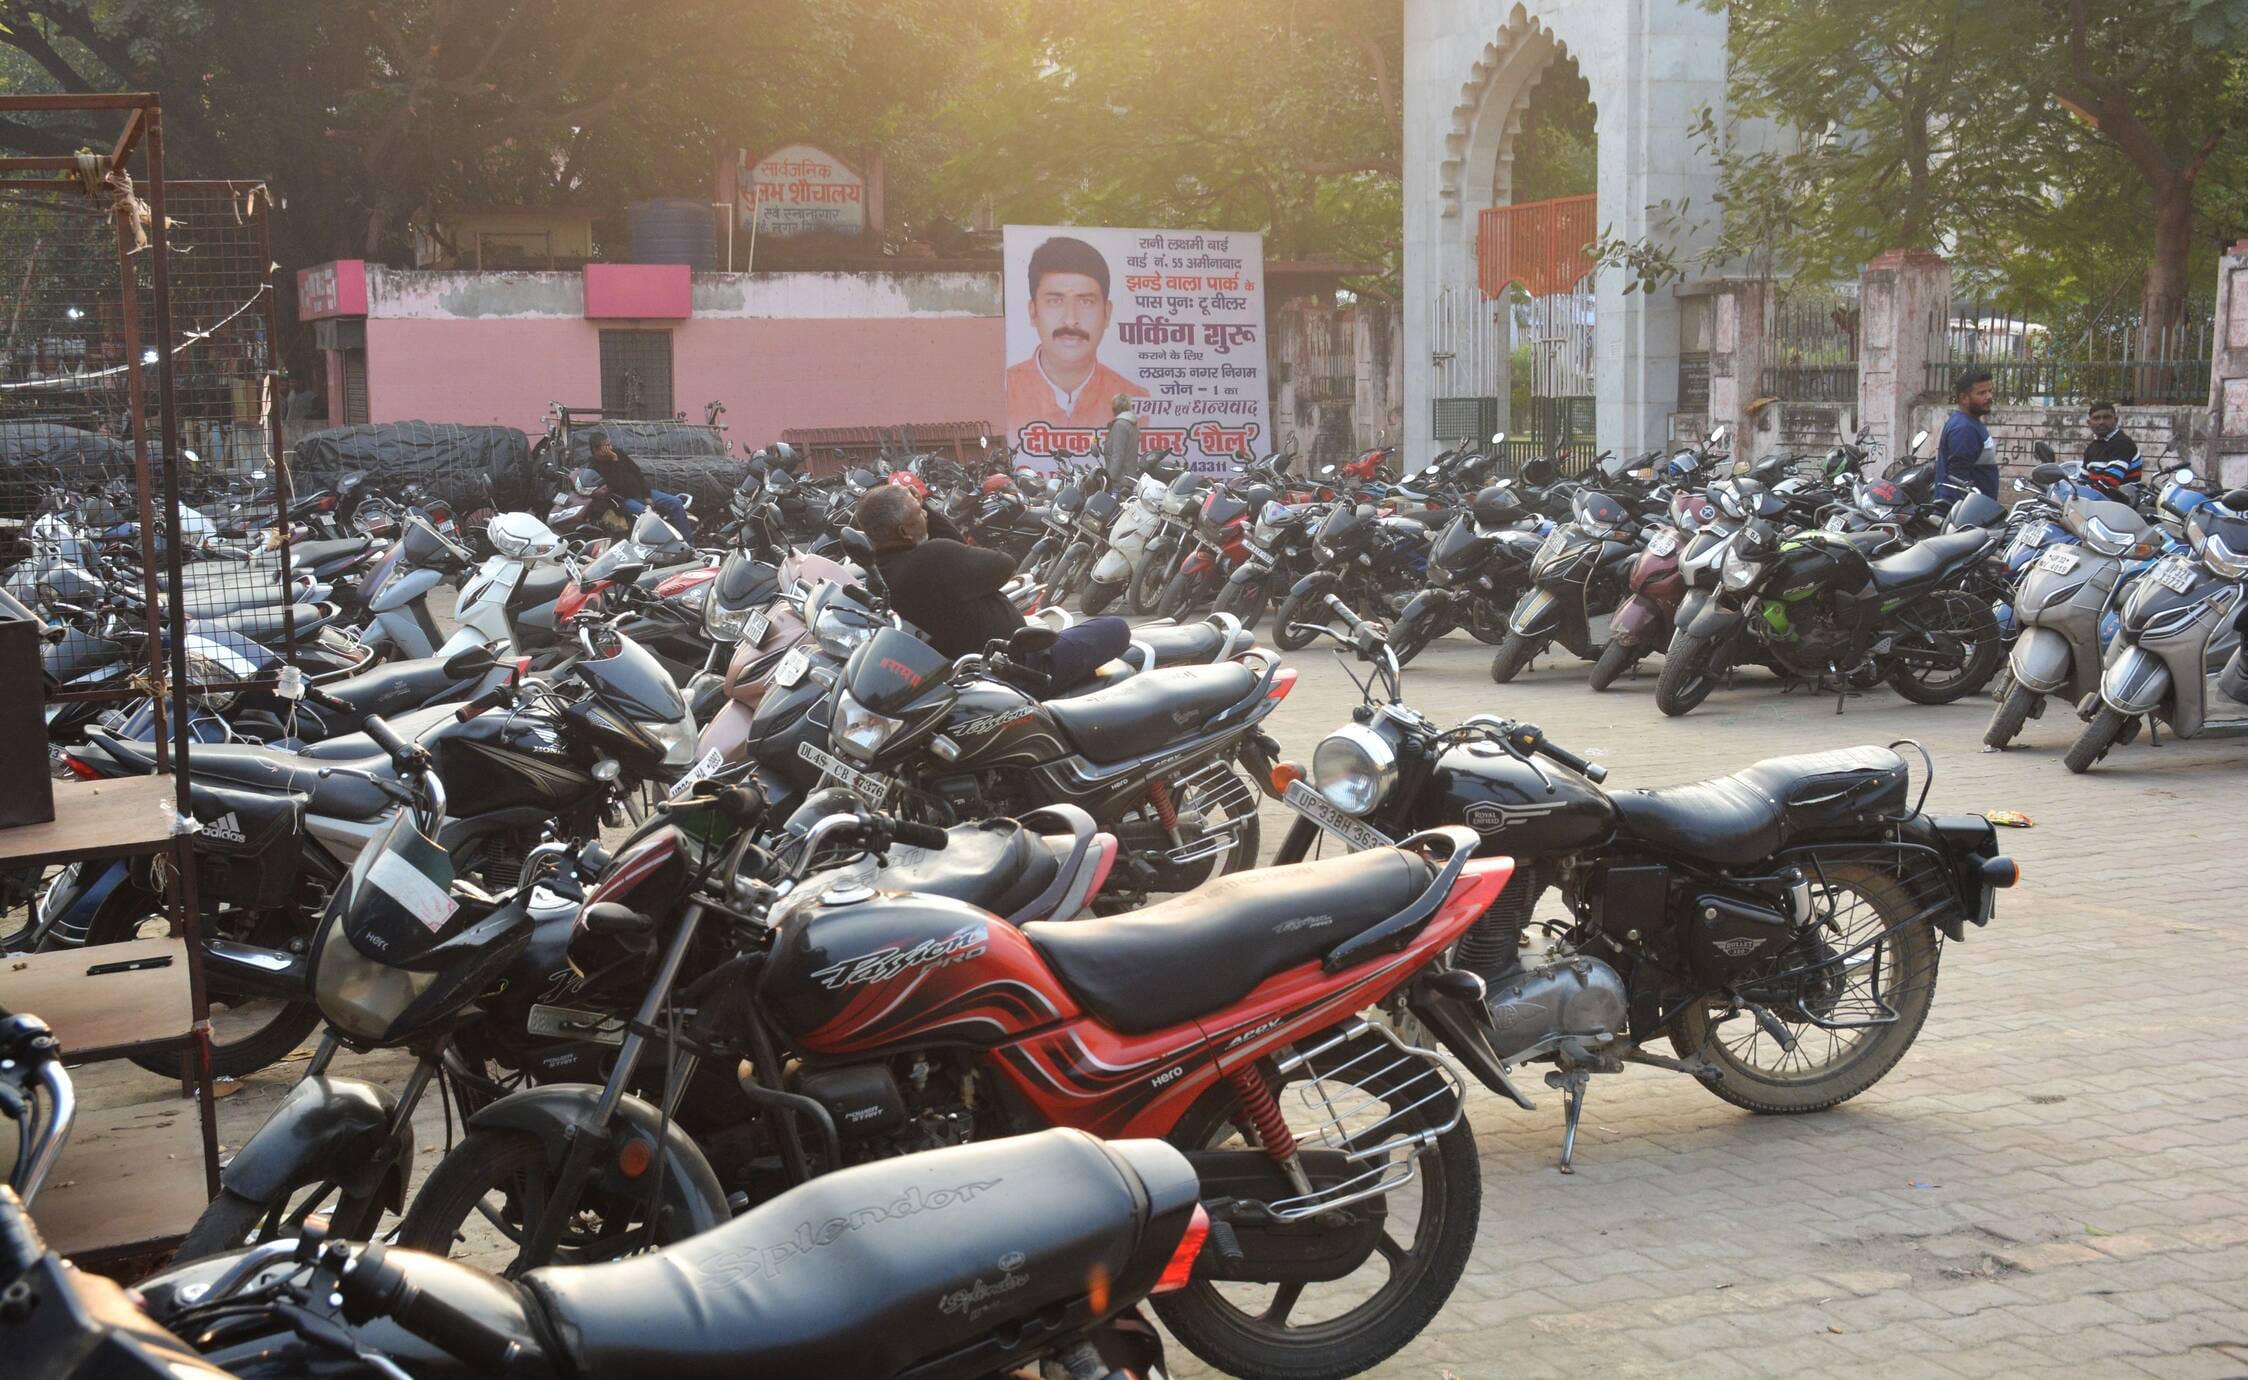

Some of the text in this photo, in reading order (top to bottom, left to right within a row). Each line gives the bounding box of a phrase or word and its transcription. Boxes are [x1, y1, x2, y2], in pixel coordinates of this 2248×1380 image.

[760, 159, 832, 178] सार्वजनिक
[1138, 234, 1164, 250] रानी
[1127, 252, 1242, 270] वार्ड नं. 55 अमीनाबाद
[1125, 271, 1255, 292] झन्डे वाला पार्क के
[1135, 292, 1247, 316] पास पुनः टू वीलर
[1202, 323, 1257, 354] शुरू
[1138, 349, 1204, 361] कराने के लिए
[1138, 362, 1257, 379] लखनऊ नगर निगम
[1160, 380, 1193, 395] जोन
[1224, 387, 1239, 395] का
[1175, 402, 1191, 416] एवं
[1022, 424, 1092, 454] दीपक
[834, 765, 850, 780] CB
[857, 777, 885, 798] 7376
[1299, 792, 1317, 809] UP
[1474, 811, 1497, 819] ROYAL
[201, 827, 246, 843] adidas
[1151, 1066, 1184, 1088] Hero
[699, 1177, 1003, 1289] Splendor
